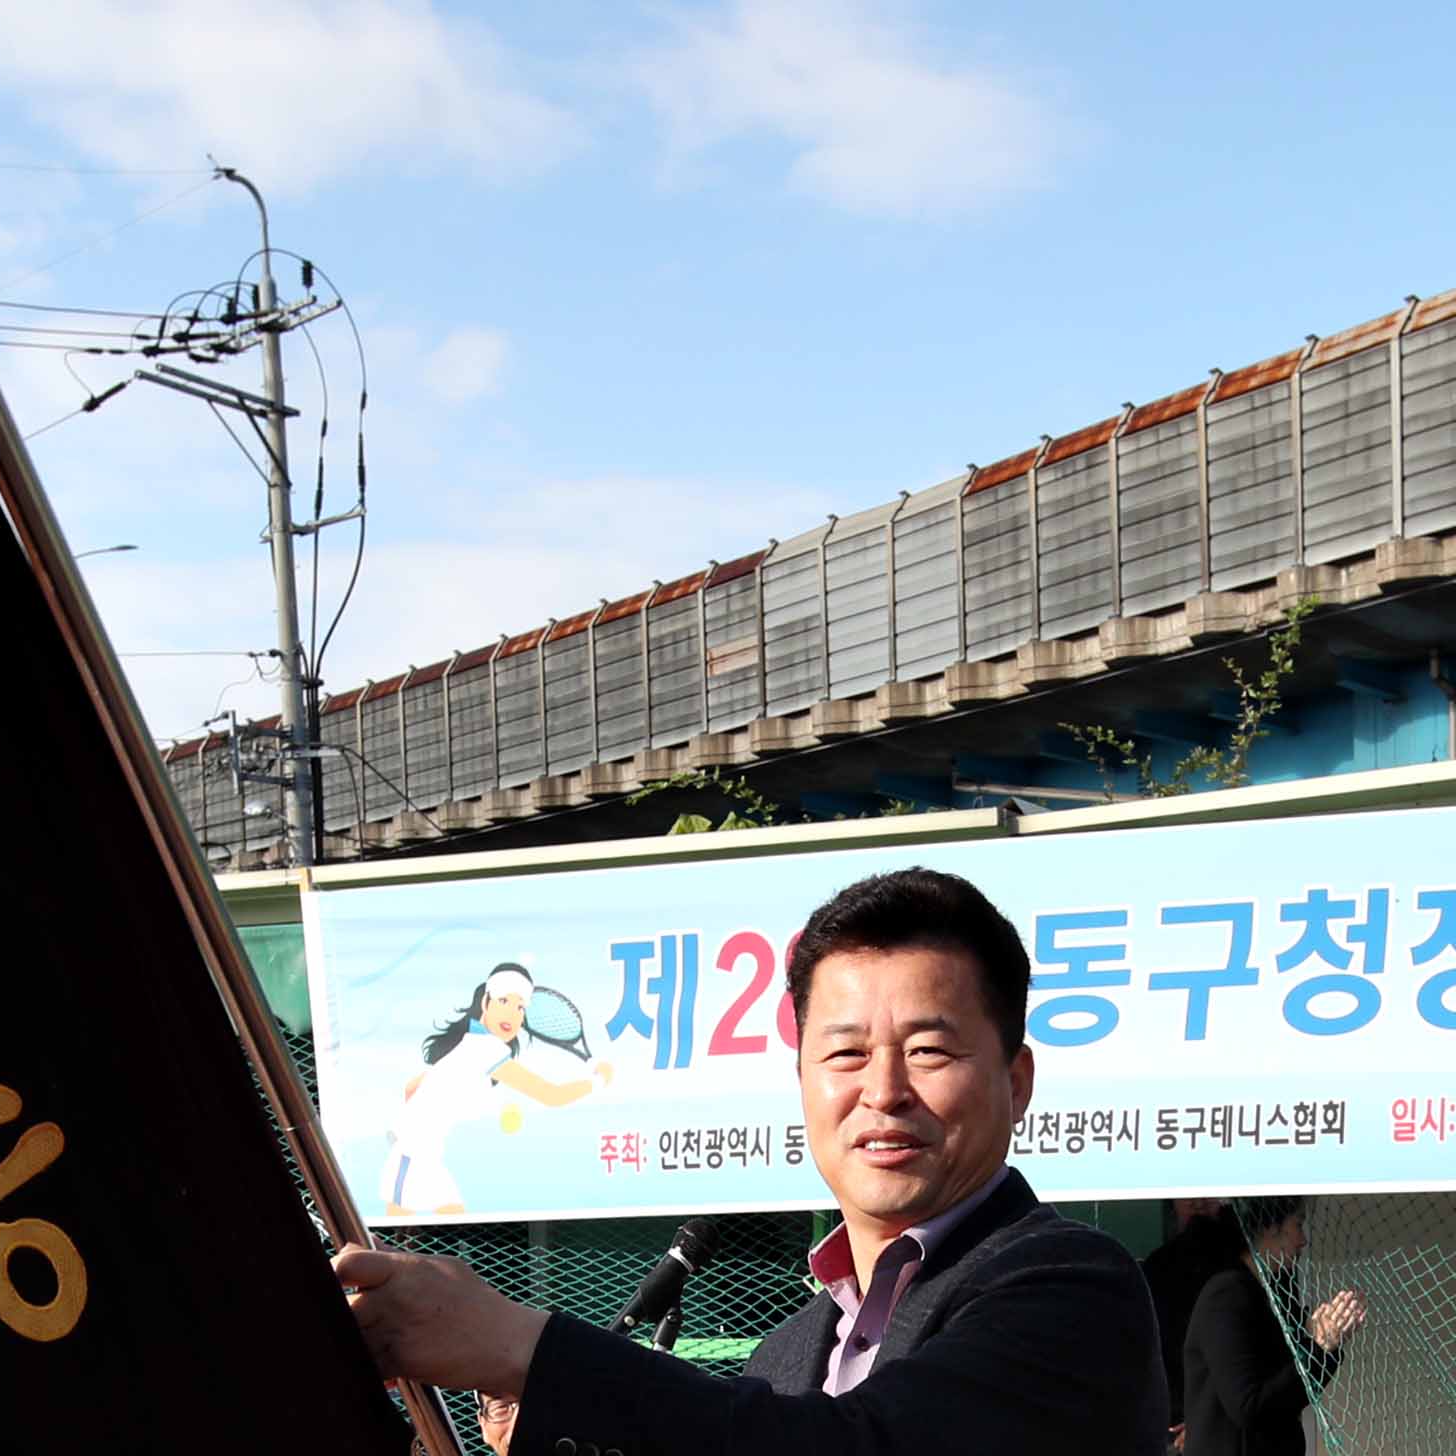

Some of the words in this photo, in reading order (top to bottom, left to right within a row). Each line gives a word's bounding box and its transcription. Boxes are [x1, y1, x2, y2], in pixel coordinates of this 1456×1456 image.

[605, 930, 802, 1069] 제2
[600, 1133, 647, 1173] 주최:
[658, 1126, 771, 1170] 인천광역시
[1014, 1108, 1141, 1155] 인천광역시
[1155, 1100, 1346, 1151] 동구테니스협회
[1391, 1097, 1455, 1142] 일시:
